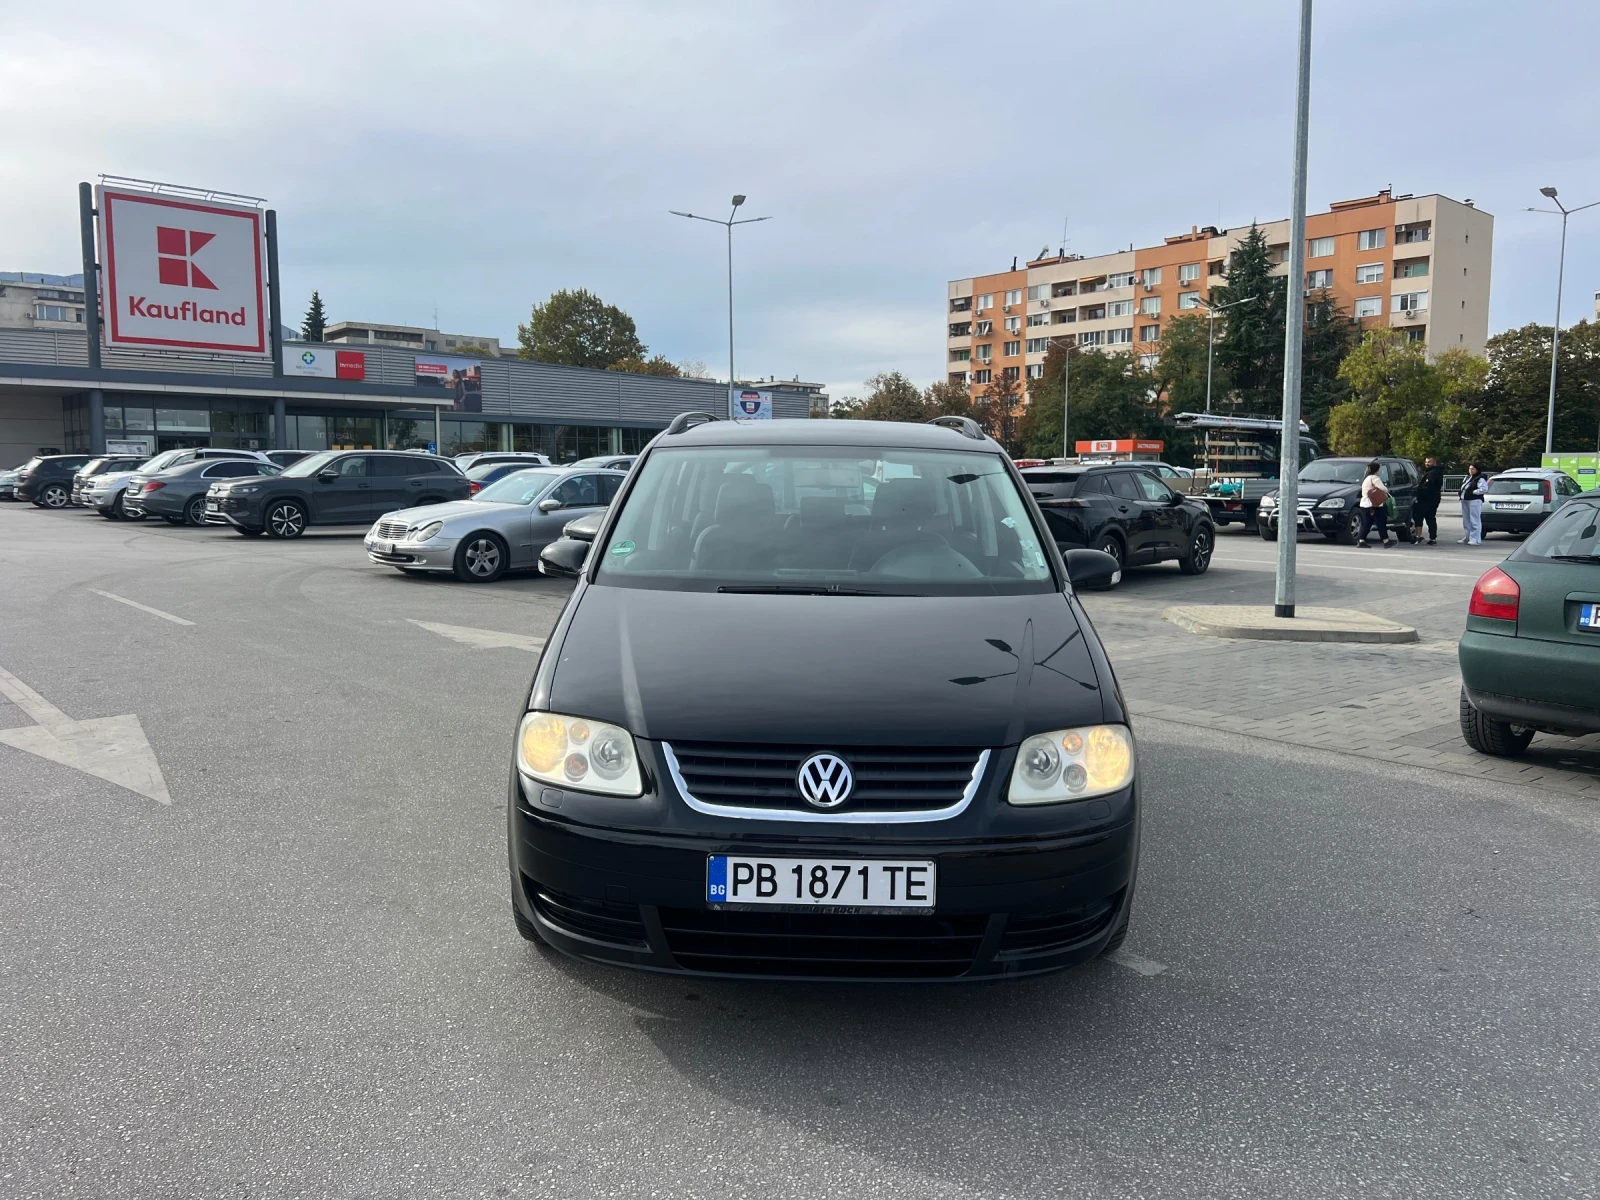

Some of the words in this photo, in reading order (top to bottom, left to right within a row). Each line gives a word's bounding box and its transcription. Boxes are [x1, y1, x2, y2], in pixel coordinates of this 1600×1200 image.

[128, 295, 246, 326] Kaufland
[710, 884, 726, 896] BG
[731, 862, 779, 898] PB
[791, 864, 869, 900] 1871
[882, 866, 928, 901] TE
